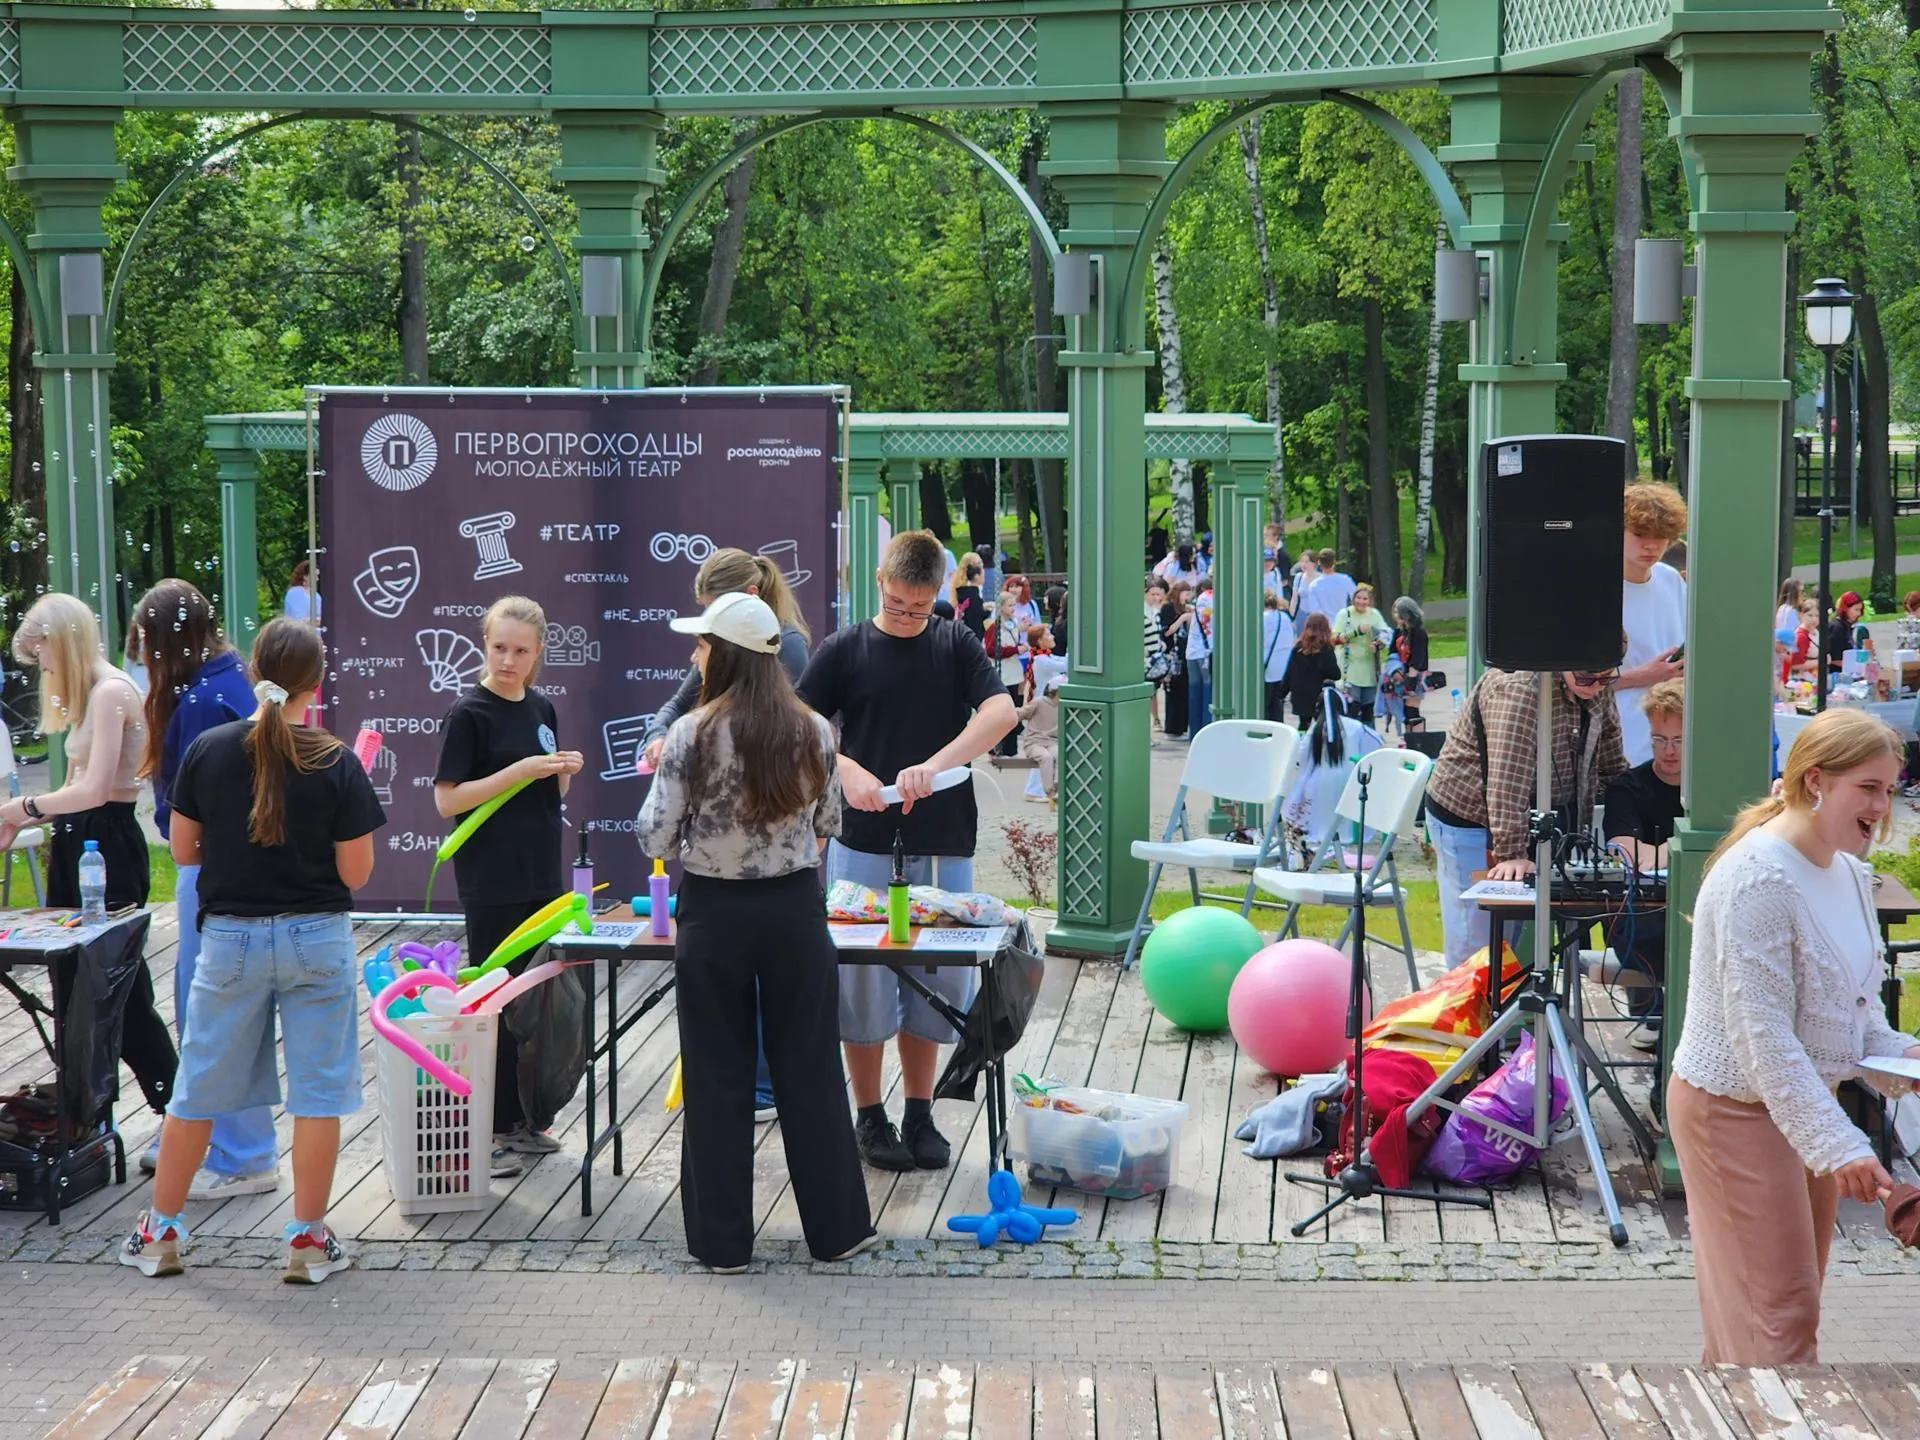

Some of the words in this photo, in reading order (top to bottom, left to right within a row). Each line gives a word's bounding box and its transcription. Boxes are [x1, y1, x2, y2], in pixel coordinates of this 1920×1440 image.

[389, 440, 410, 466] П
[455, 432, 702, 458] ПЕРВОПРОХОДЦЫ
[727, 445, 822, 461] росмолодёжь
[475, 457, 621, 479] МОЛОДЁЖНЫЙ
[628, 460, 682, 478] ТЕАТР
[758, 459, 790, 467] гранты
[540, 524, 620, 542] #ТЕАТР
[564, 573, 630, 584] #СПЕКТАКЛЬ
[347, 657, 406, 668] #АНТРАКТ
[1484, 1125, 1525, 1164] WB
